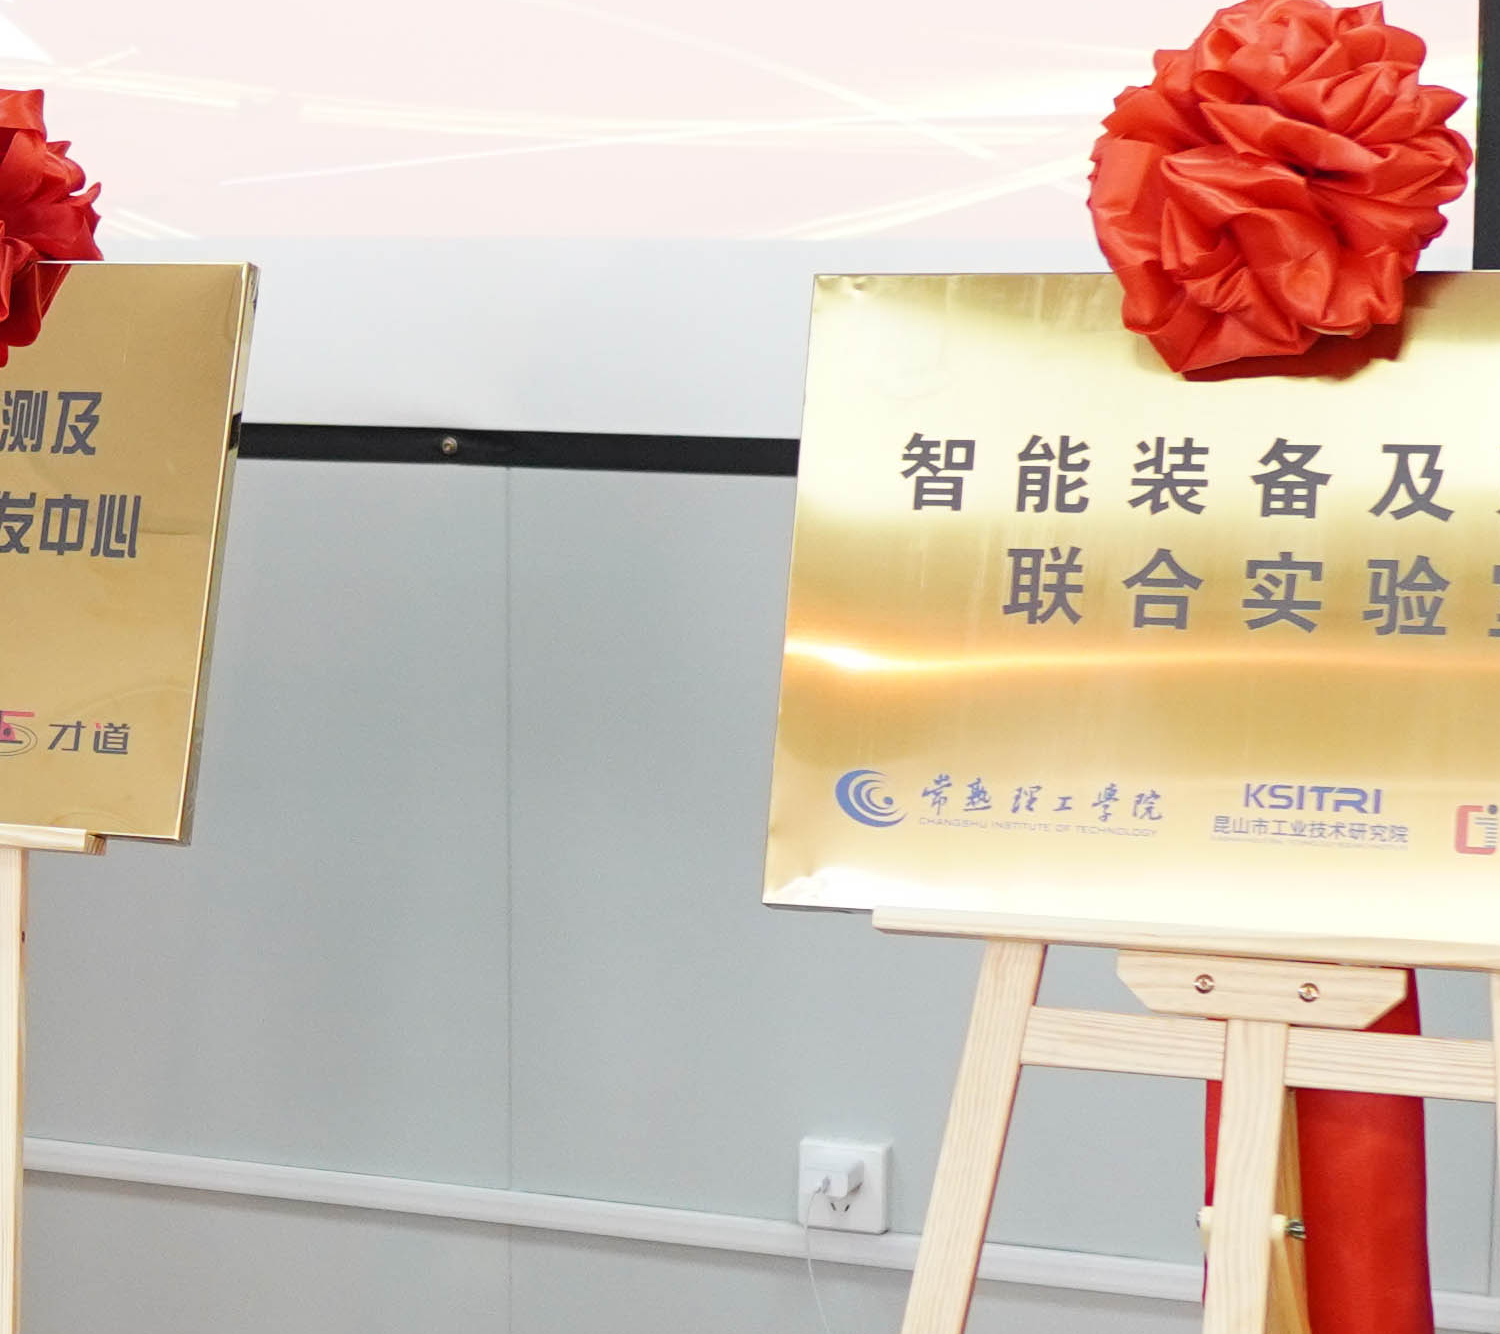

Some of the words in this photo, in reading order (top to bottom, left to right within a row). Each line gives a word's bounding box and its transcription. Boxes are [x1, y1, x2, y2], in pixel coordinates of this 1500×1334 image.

[47, 720, 131, 756] 才道
[1244, 782, 1384, 815] KSITRI
[991, 820, 1050, 833] INSTITUTE
[1055, 824, 1071, 834] OF
[1076, 824, 1158, 838] TECHNOLOGY
[1212, 814, 1409, 844] 昆山市工业技术研究院
